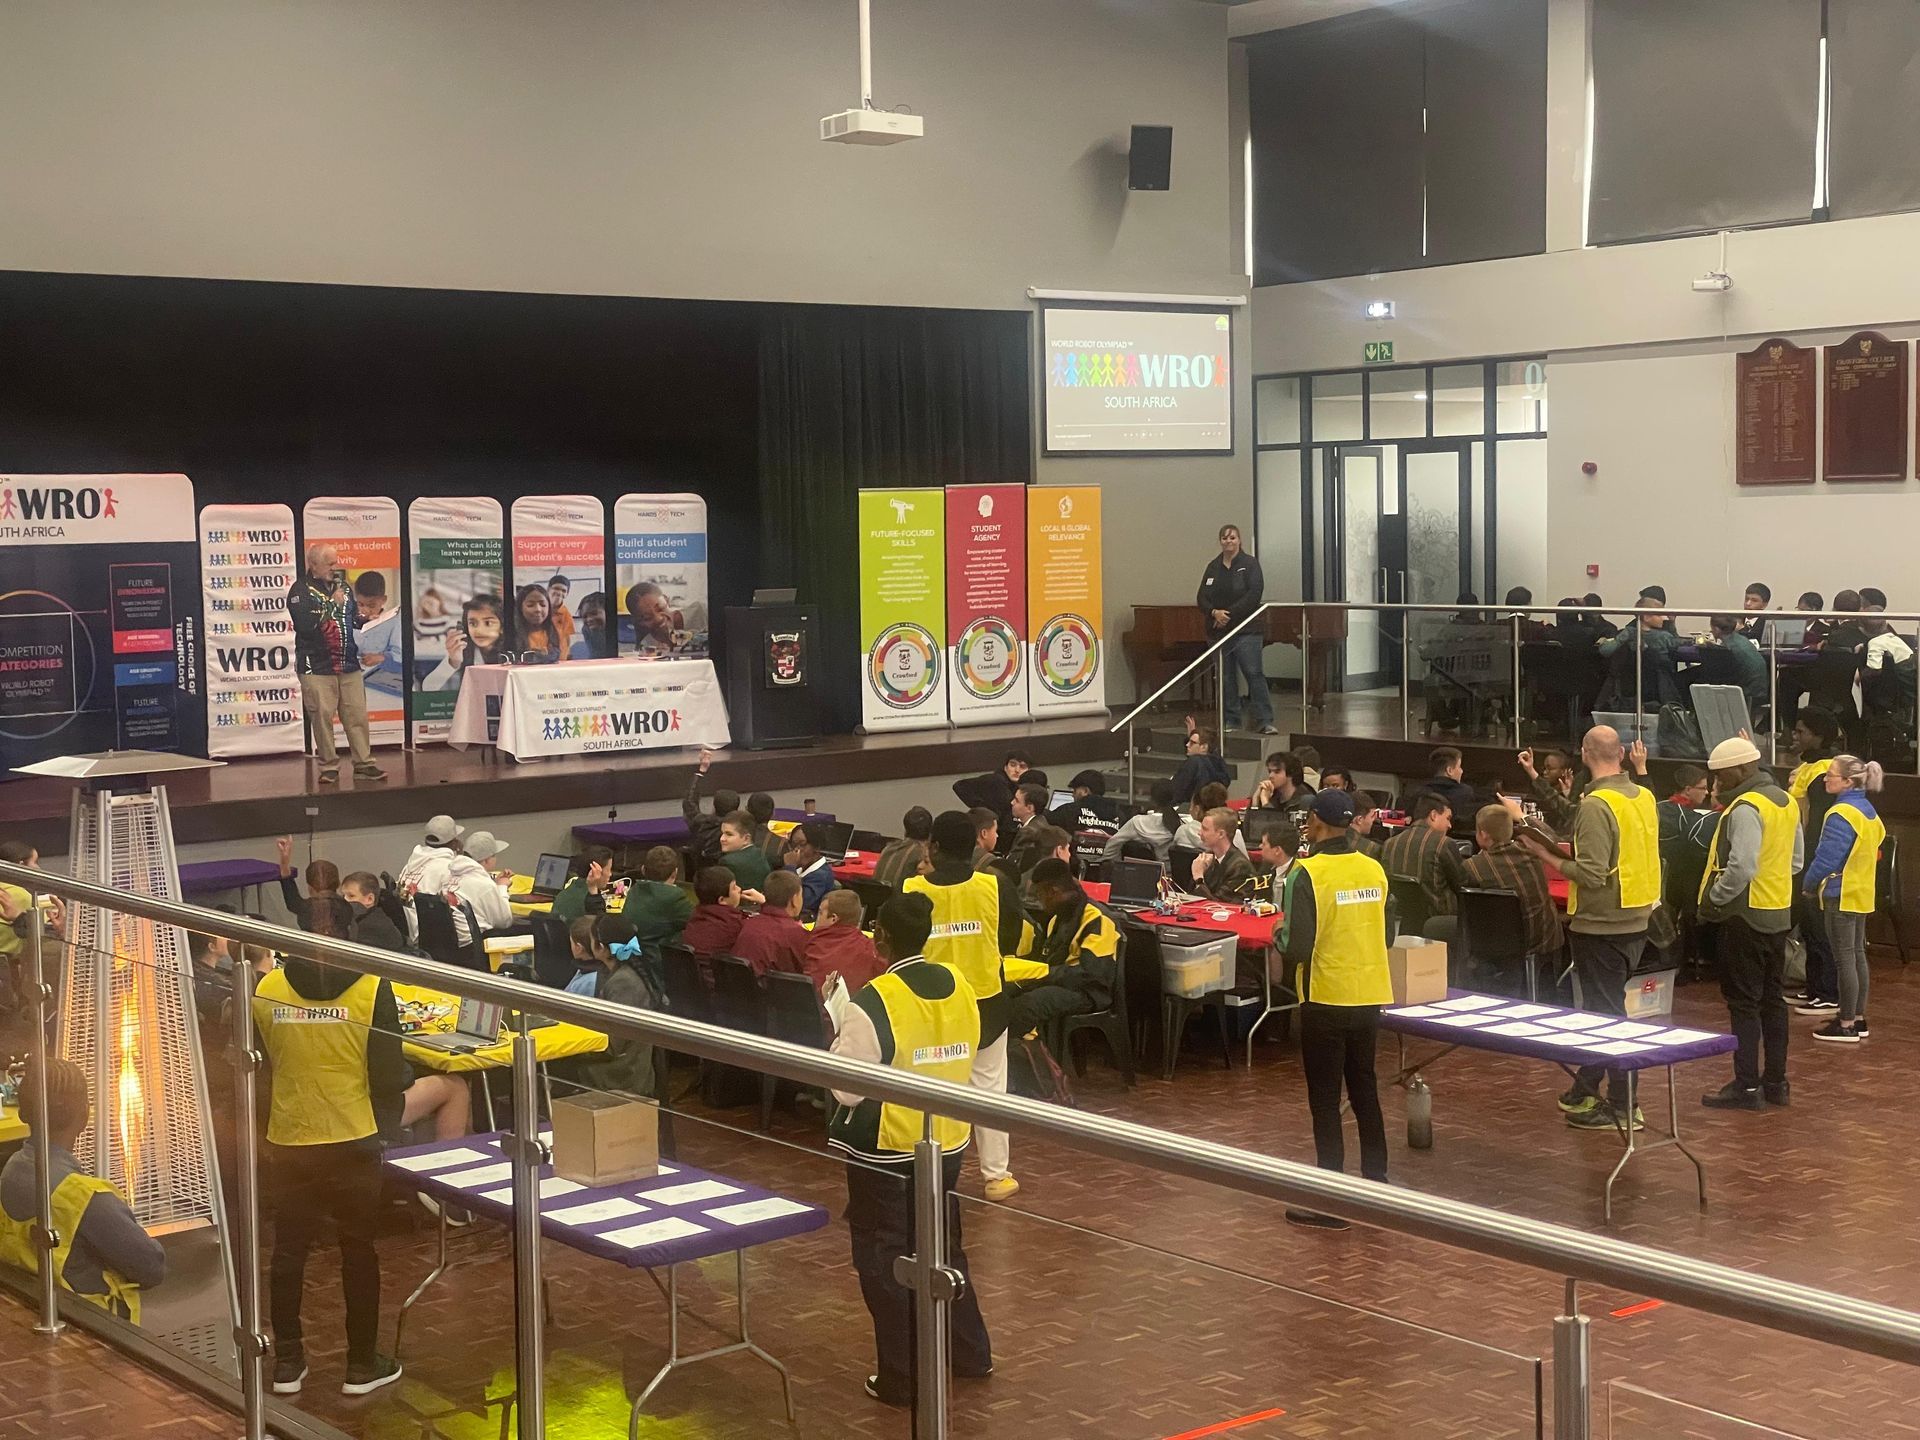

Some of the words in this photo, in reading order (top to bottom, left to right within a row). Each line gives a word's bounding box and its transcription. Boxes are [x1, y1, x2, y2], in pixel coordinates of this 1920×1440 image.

[1139, 353, 1213, 388] WRO
[1104, 396, 1140, 408] SOUTH
[1143, 396, 1177, 408] AFRICA
[17, 488, 101, 520] WRO
[23, 527, 65, 538] AFRICA
[971, 524, 1001, 533] STUDENT
[1040, 524, 1060, 532] LOCAL
[247, 530, 281, 543] WRO
[617, 538, 644, 547] Build
[647, 537, 688, 547] student
[1048, 533, 1085, 541] RELEVANCE
[353, 541, 392, 550] student
[447, 541, 468, 549] What
[485, 541, 502, 549] kids
[517, 541, 557, 550] Support
[560, 541, 587, 550] every
[249, 552, 283, 566] WRO
[441, 549, 460, 557] learn
[485, 549, 502, 557] play
[518, 553, 562, 562] student's
[618, 550, 677, 559] confidence
[250, 575, 284, 588] WRO
[251, 597, 286, 611] WRO
[251, 620, 287, 634] WRO
[0, 644, 64, 658] OMPETITION
[176, 622, 186, 690] TECHNOLOGY
[0, 658, 64, 671] ATEGORIES
[187, 642, 196, 679] CHOICE
[216, 645, 289, 673] WRO
[188, 681, 196, 695] OF
[255, 688, 289, 701] WRO
[257, 710, 291, 724] WRO
[610, 709, 669, 736] WRO
[583, 740, 612, 750] SOUTH
[613, 738, 643, 748] AFRICA
[1357, 888, 1378, 900] WRO
[952, 921, 975, 934] WRO
[944, 1044, 962, 1057] WRO
